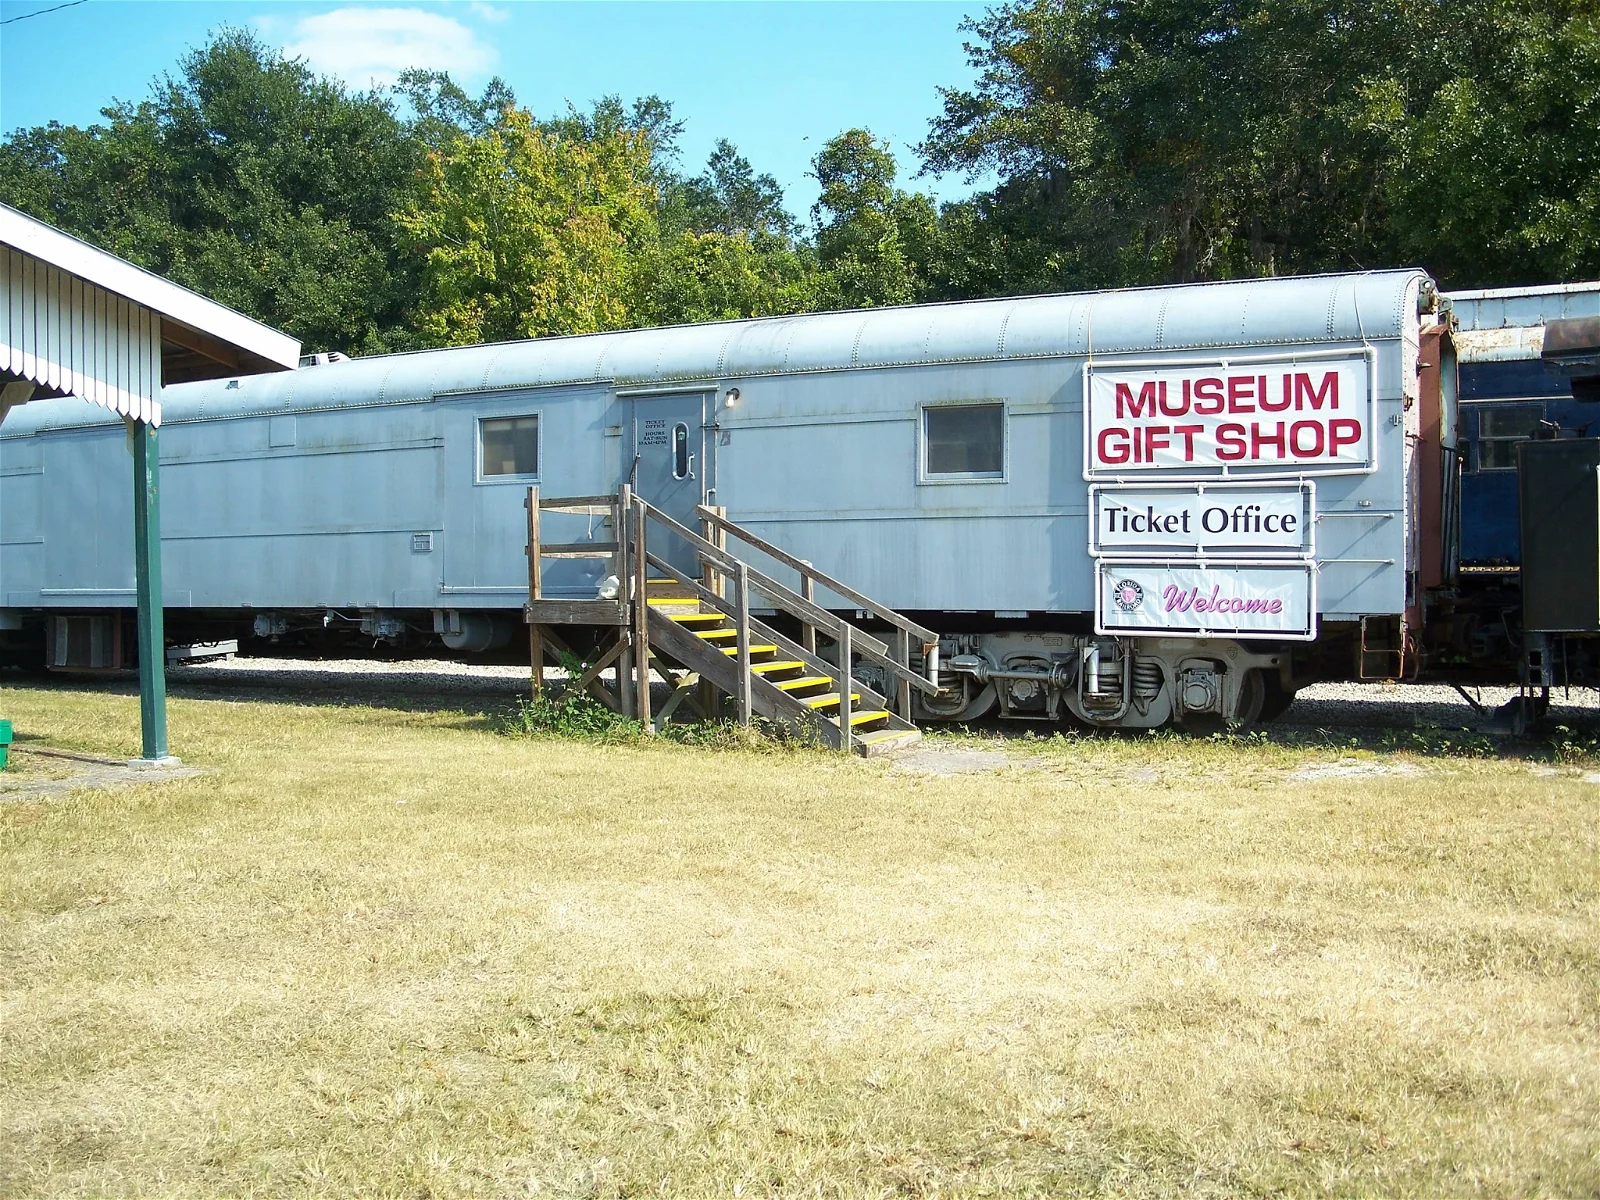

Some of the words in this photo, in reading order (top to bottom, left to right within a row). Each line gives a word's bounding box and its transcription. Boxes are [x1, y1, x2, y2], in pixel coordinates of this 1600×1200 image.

[1115, 371, 1339, 419] MUSEUM
[1097, 424, 1205, 464] GIFT
[1215, 418, 1362, 461] SHOP
[1104, 506, 1191, 534] Ticket
[1202, 505, 1297, 534] Office
[1163, 584, 1283, 615] Welcome
